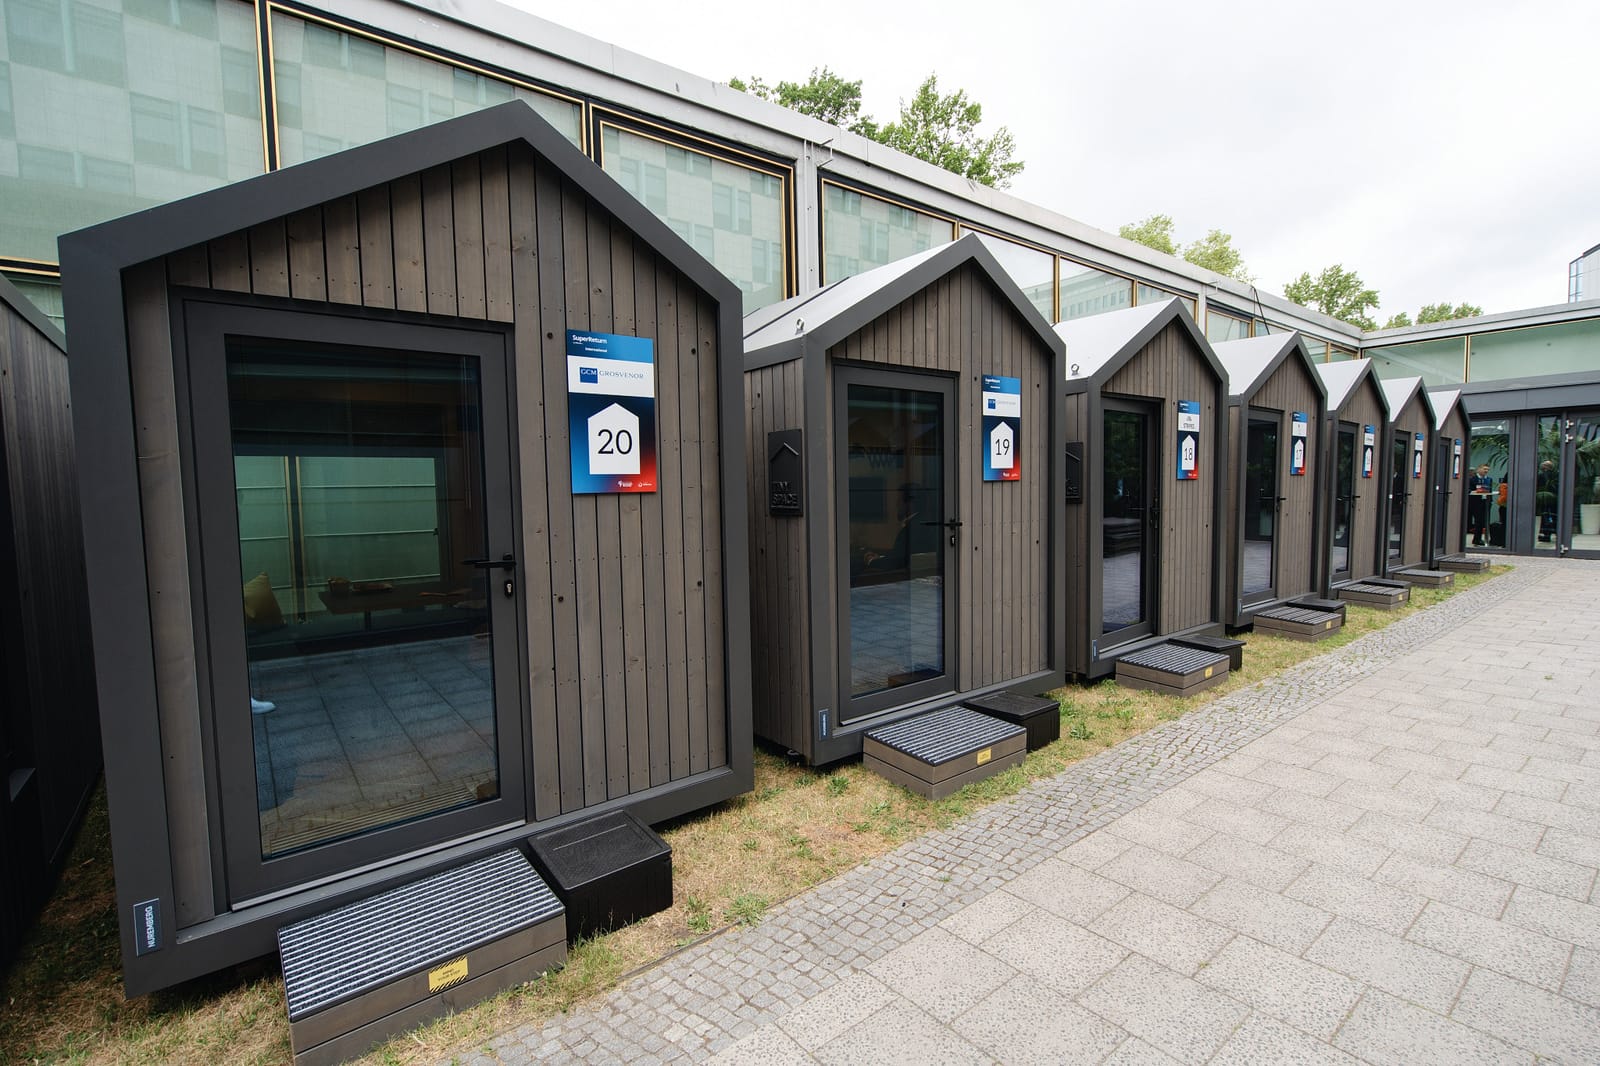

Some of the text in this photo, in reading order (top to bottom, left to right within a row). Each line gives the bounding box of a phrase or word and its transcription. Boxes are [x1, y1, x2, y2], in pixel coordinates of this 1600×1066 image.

[572, 334, 608, 345] SuperReturn
[580, 368, 644, 379] GCM GROSVENOR
[598, 429, 633, 455] 20
[995, 438, 1010, 456] 19
[1184, 447, 1193, 461] 18
[144, 905, 156, 948] NUREMBERG
